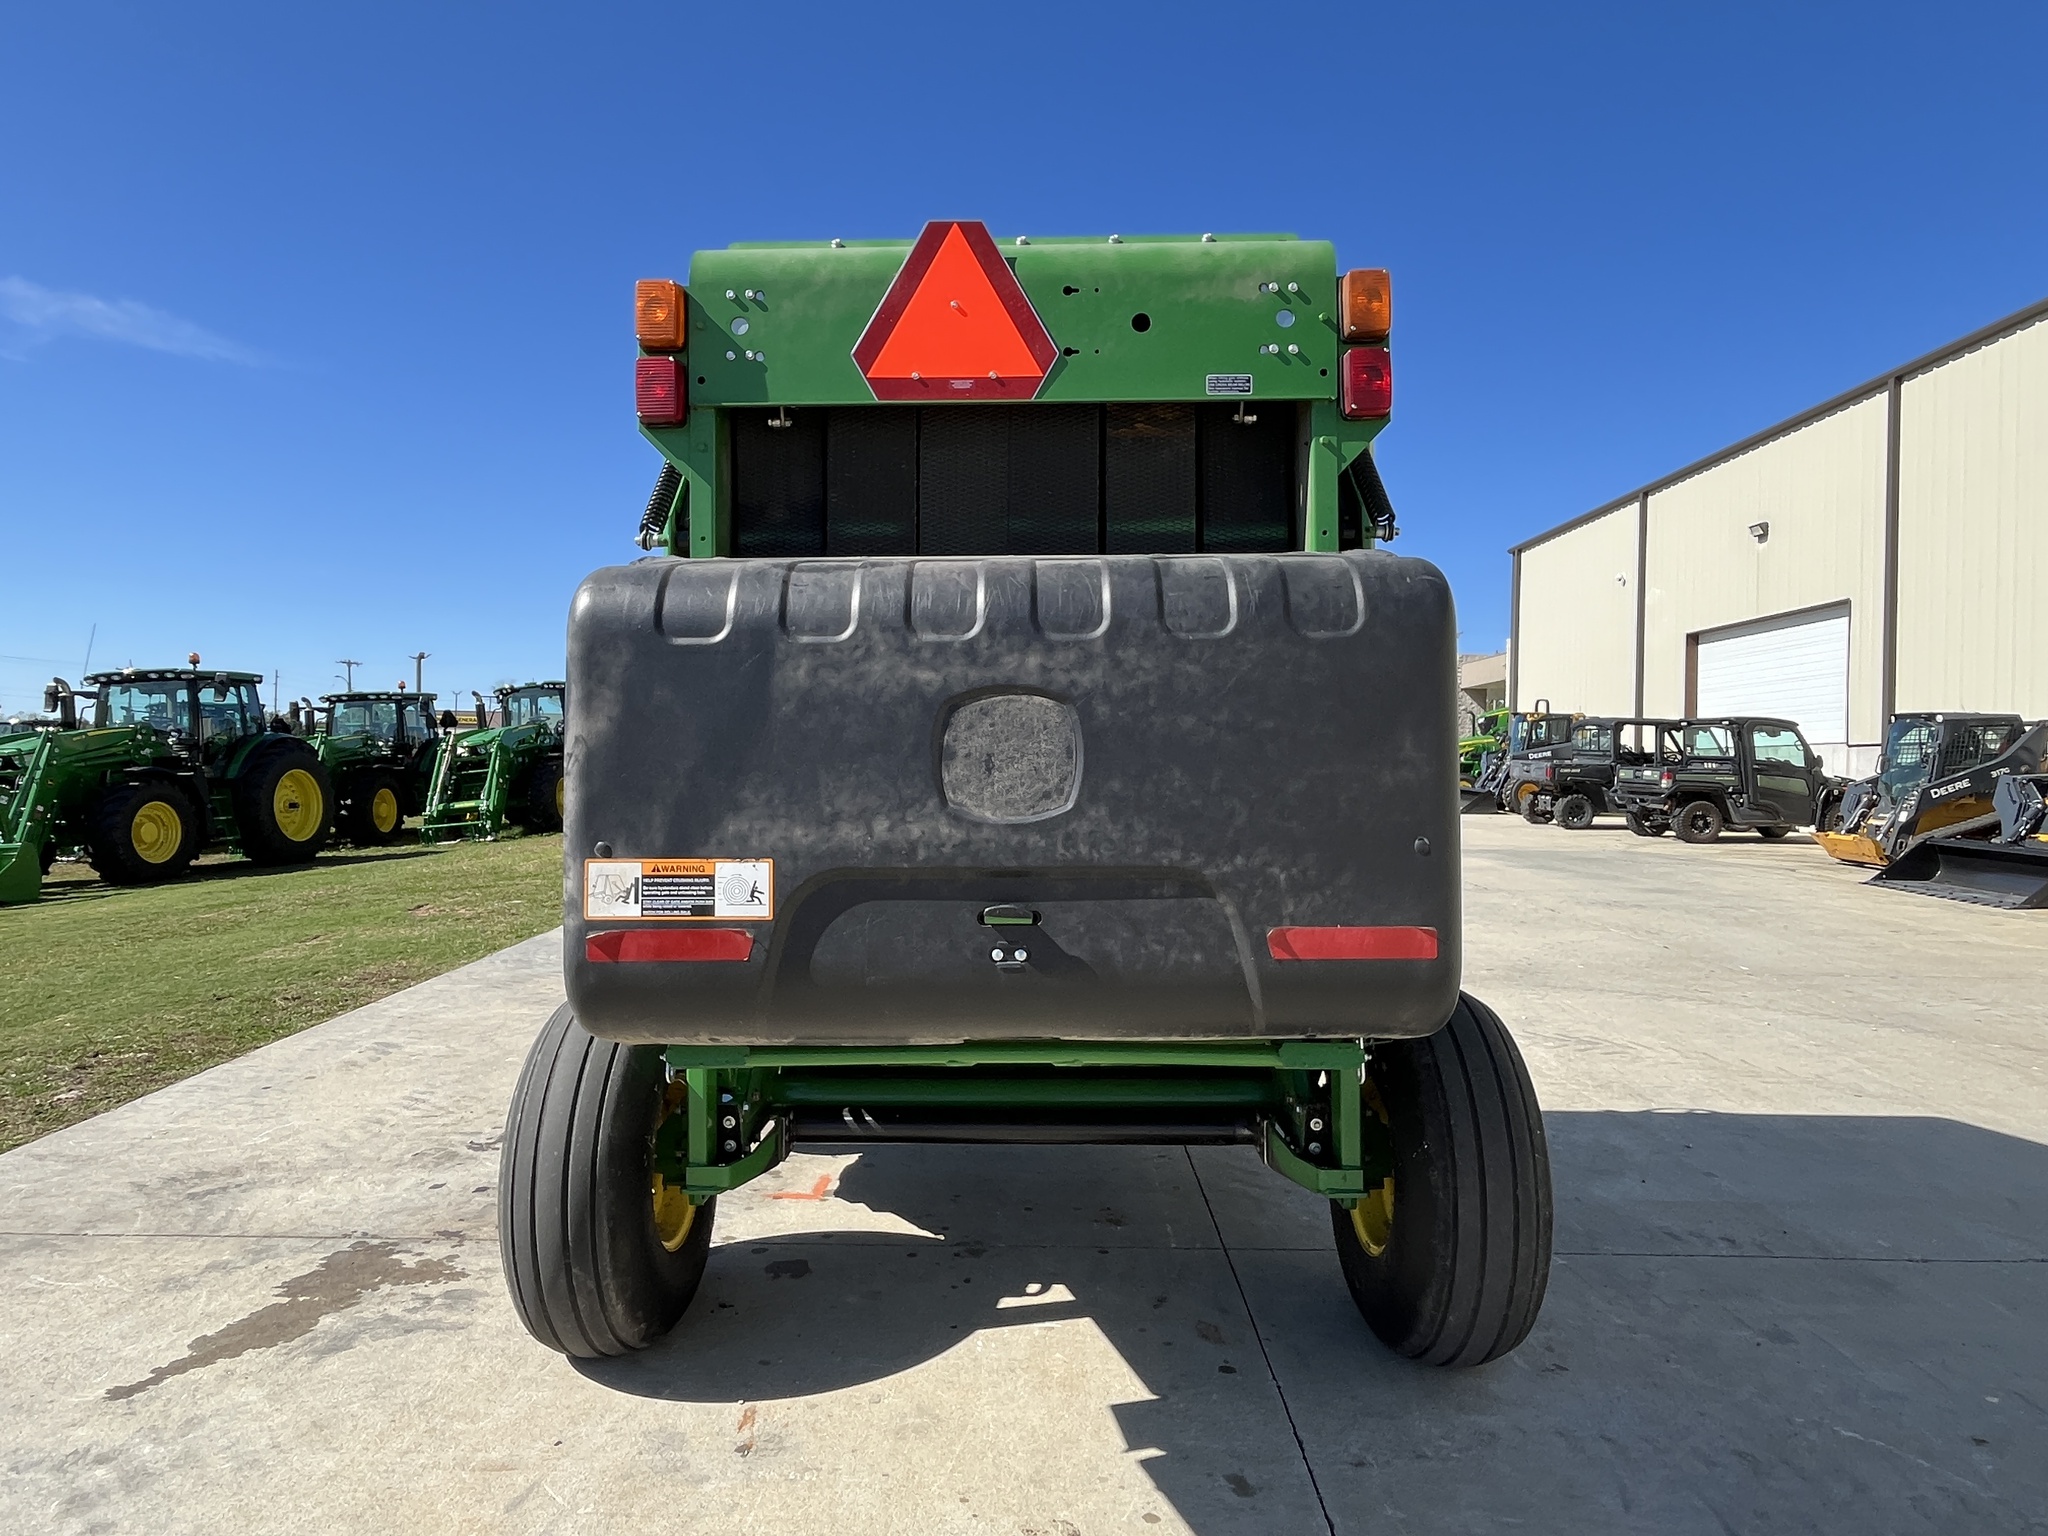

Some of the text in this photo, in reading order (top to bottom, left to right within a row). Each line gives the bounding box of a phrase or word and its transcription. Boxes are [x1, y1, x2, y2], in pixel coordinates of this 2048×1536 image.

[1528, 750, 1552, 760] DEERE
[1929, 778, 1971, 799] DEERE
[661, 865, 705, 873] WARNING
